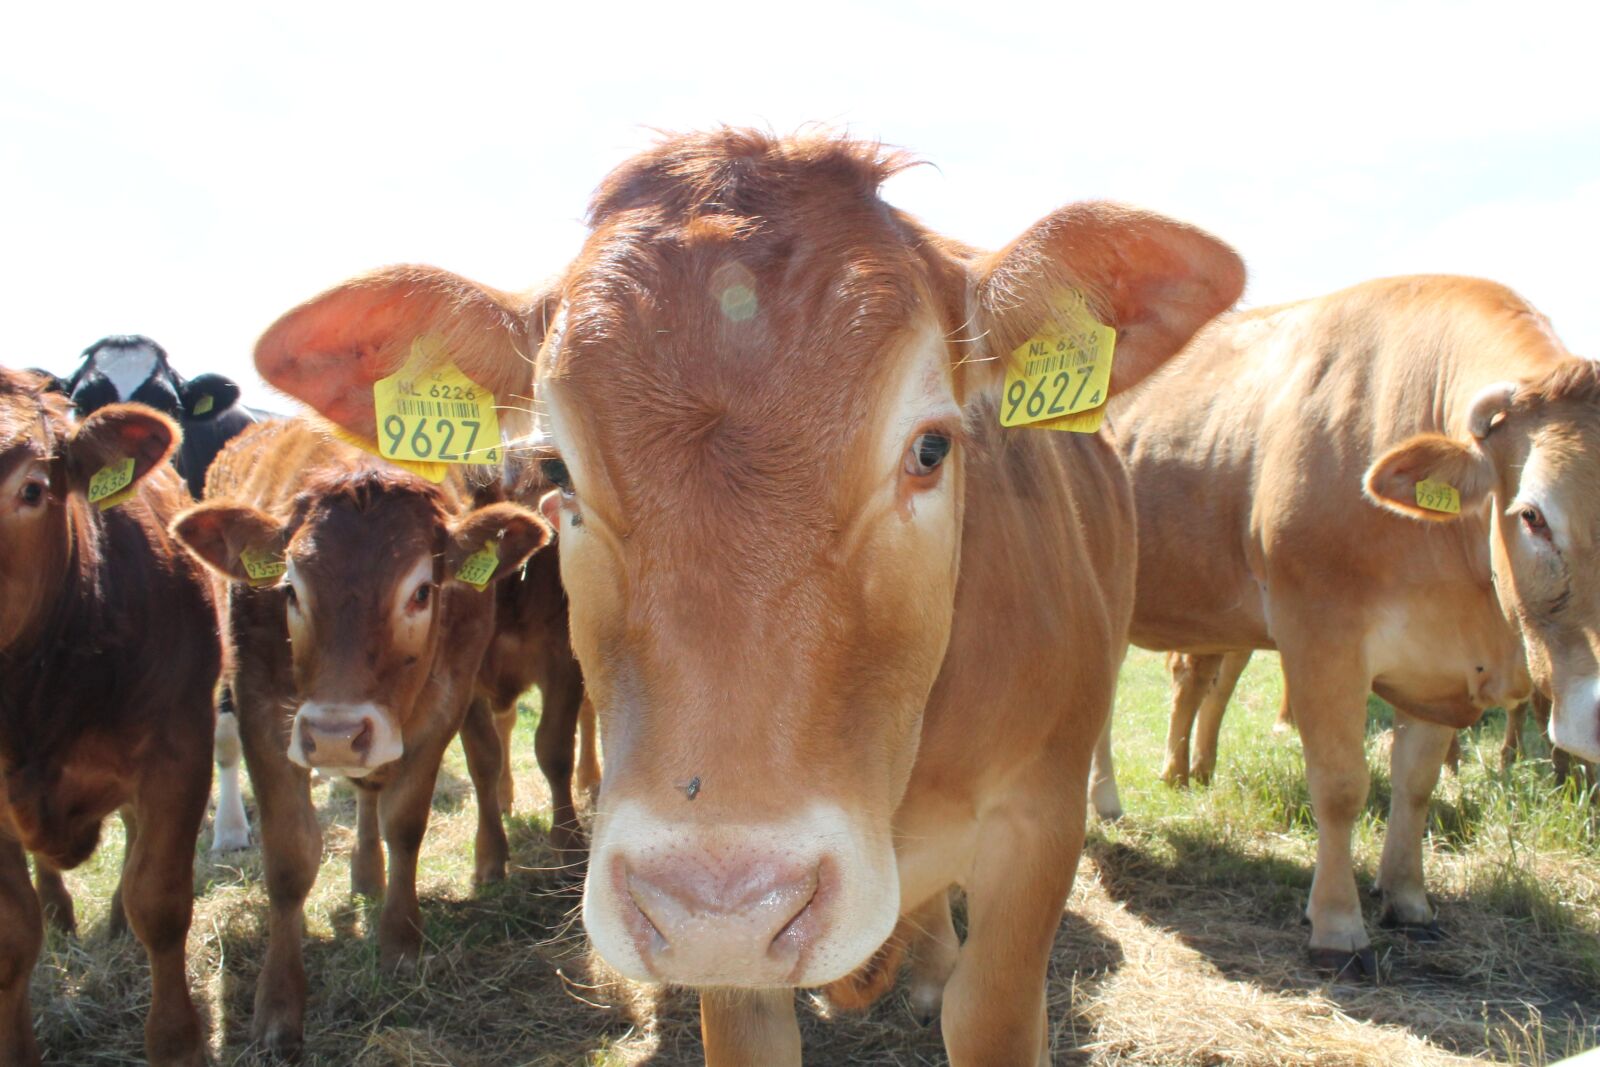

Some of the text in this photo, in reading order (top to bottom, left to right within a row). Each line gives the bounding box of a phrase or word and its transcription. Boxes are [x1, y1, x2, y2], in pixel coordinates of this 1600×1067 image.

[1028, 341, 1049, 357] NL
[398, 381, 476, 401] NL 6226
[1006, 365, 1095, 422] 9627
[384, 414, 480, 461] 9627
